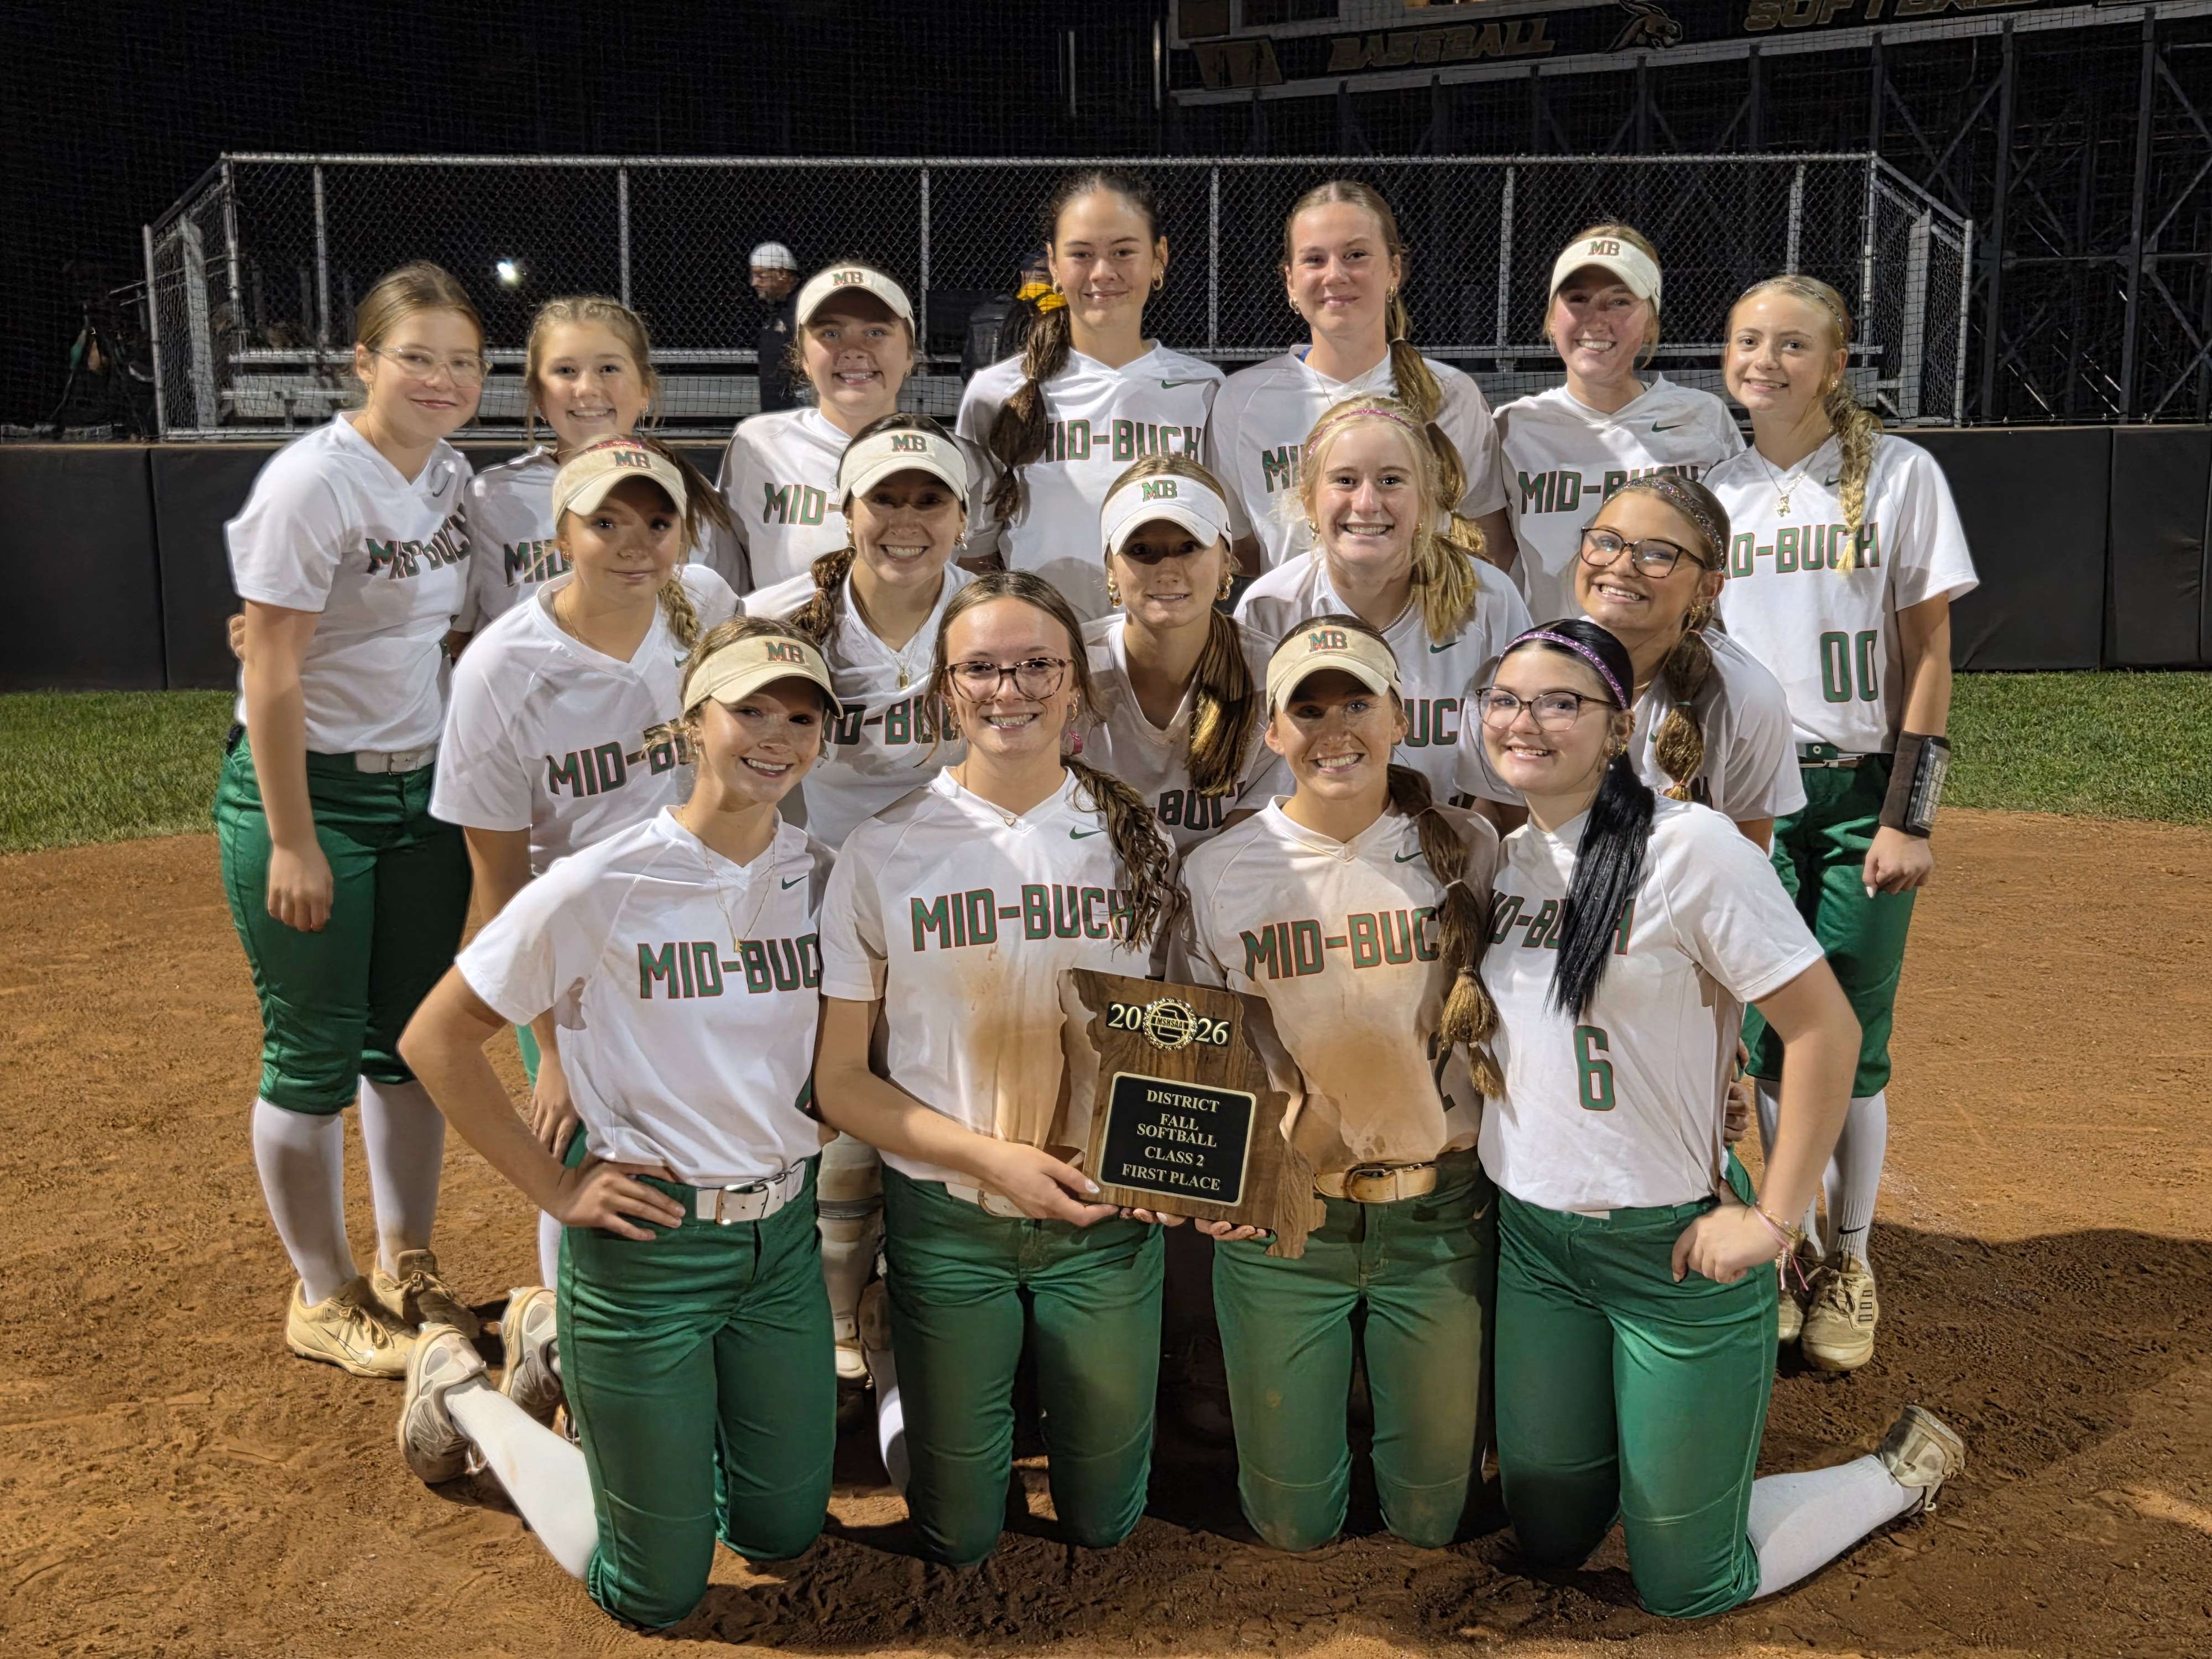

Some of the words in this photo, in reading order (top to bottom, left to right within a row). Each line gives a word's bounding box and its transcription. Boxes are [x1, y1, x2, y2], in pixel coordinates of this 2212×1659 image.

[1328, 17, 1555, 71] BASEBALL
[1588, 240, 1620, 256] MB
[833, 271, 863, 286] MB
[891, 435, 927, 453] MB
[615, 451, 651, 469] MB
[1142, 479, 1178, 502] MB
[765, 641, 806, 664] MB
[1308, 630, 1348, 653] MB
[1820, 629, 1879, 703] 00
[1108, 1003, 1141, 1031] 20
[1194, 1018, 1228, 1045] 26
[1573, 1025, 1615, 1112] 6
[1146, 1089, 1220, 1113] DISTRICT
[1160, 1113, 1199, 1131] FALL
[1136, 1124, 1217, 1147] SOFTBALL
[1144, 1146, 1194, 1165] CLASS
[1196, 1155, 1204, 1167] 2
[1121, 1164, 1167, 1182] FIRST
[1170, 1171, 1221, 1191] PLACE
